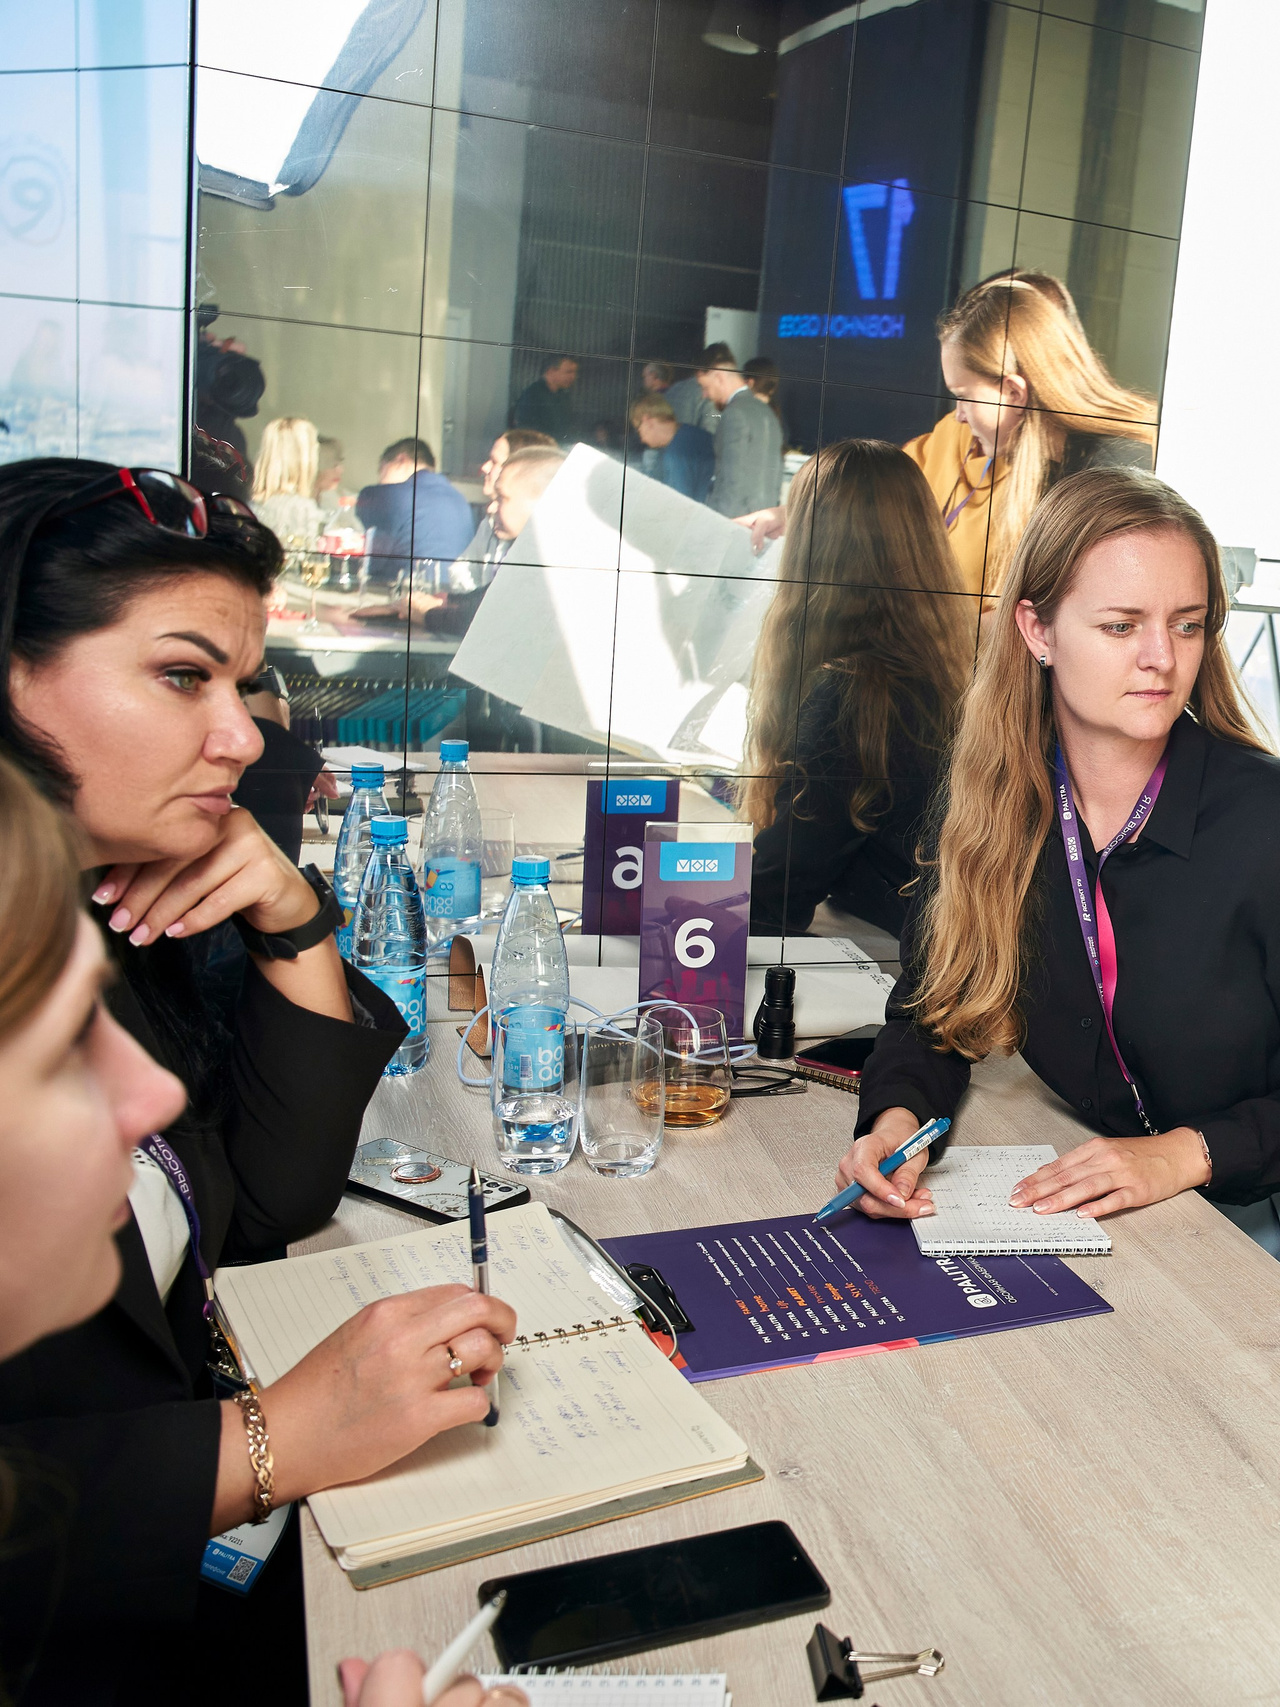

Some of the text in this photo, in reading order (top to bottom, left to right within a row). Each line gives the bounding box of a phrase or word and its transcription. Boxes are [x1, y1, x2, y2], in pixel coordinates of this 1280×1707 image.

[1060, 784, 1069, 811] PALITRA
[1102, 795, 1153, 858] Я НА ВЫСОТЕ
[675, 918, 716, 968] 6
[151, 1134, 189, 1193] ВЫСОТЕ
[936, 1256, 982, 1294] PALITR
[807, 1285, 825, 1303] Prestige
[825, 1283, 843, 1300] Simple
[845, 1283, 862, 1297] Style
[864, 1279, 881, 1295] TREND
[988, 1278, 1017, 1304] ОБОЙНАЯ
[754, 1296, 769, 1312] home
[786, 1288, 807, 1306] PLANET
[881, 1297, 898, 1313] PALITRA
[736, 1300, 750, 1314] FAMILY
[823, 1305, 840, 1322] PALITRA
[842, 1303, 859, 1319] PALITRA
[861, 1299, 879, 1316] PALITRA
[768, 1314, 784, 1331] PALITRA
[787, 1312, 803, 1328] PALITRA
[805, 1308, 822, 1325] PALITRA
[748, 1317, 765, 1334] PALITRA
[229, 1535, 243, 1545] 92211
[219, 1551, 236, 1561] PALITRA
